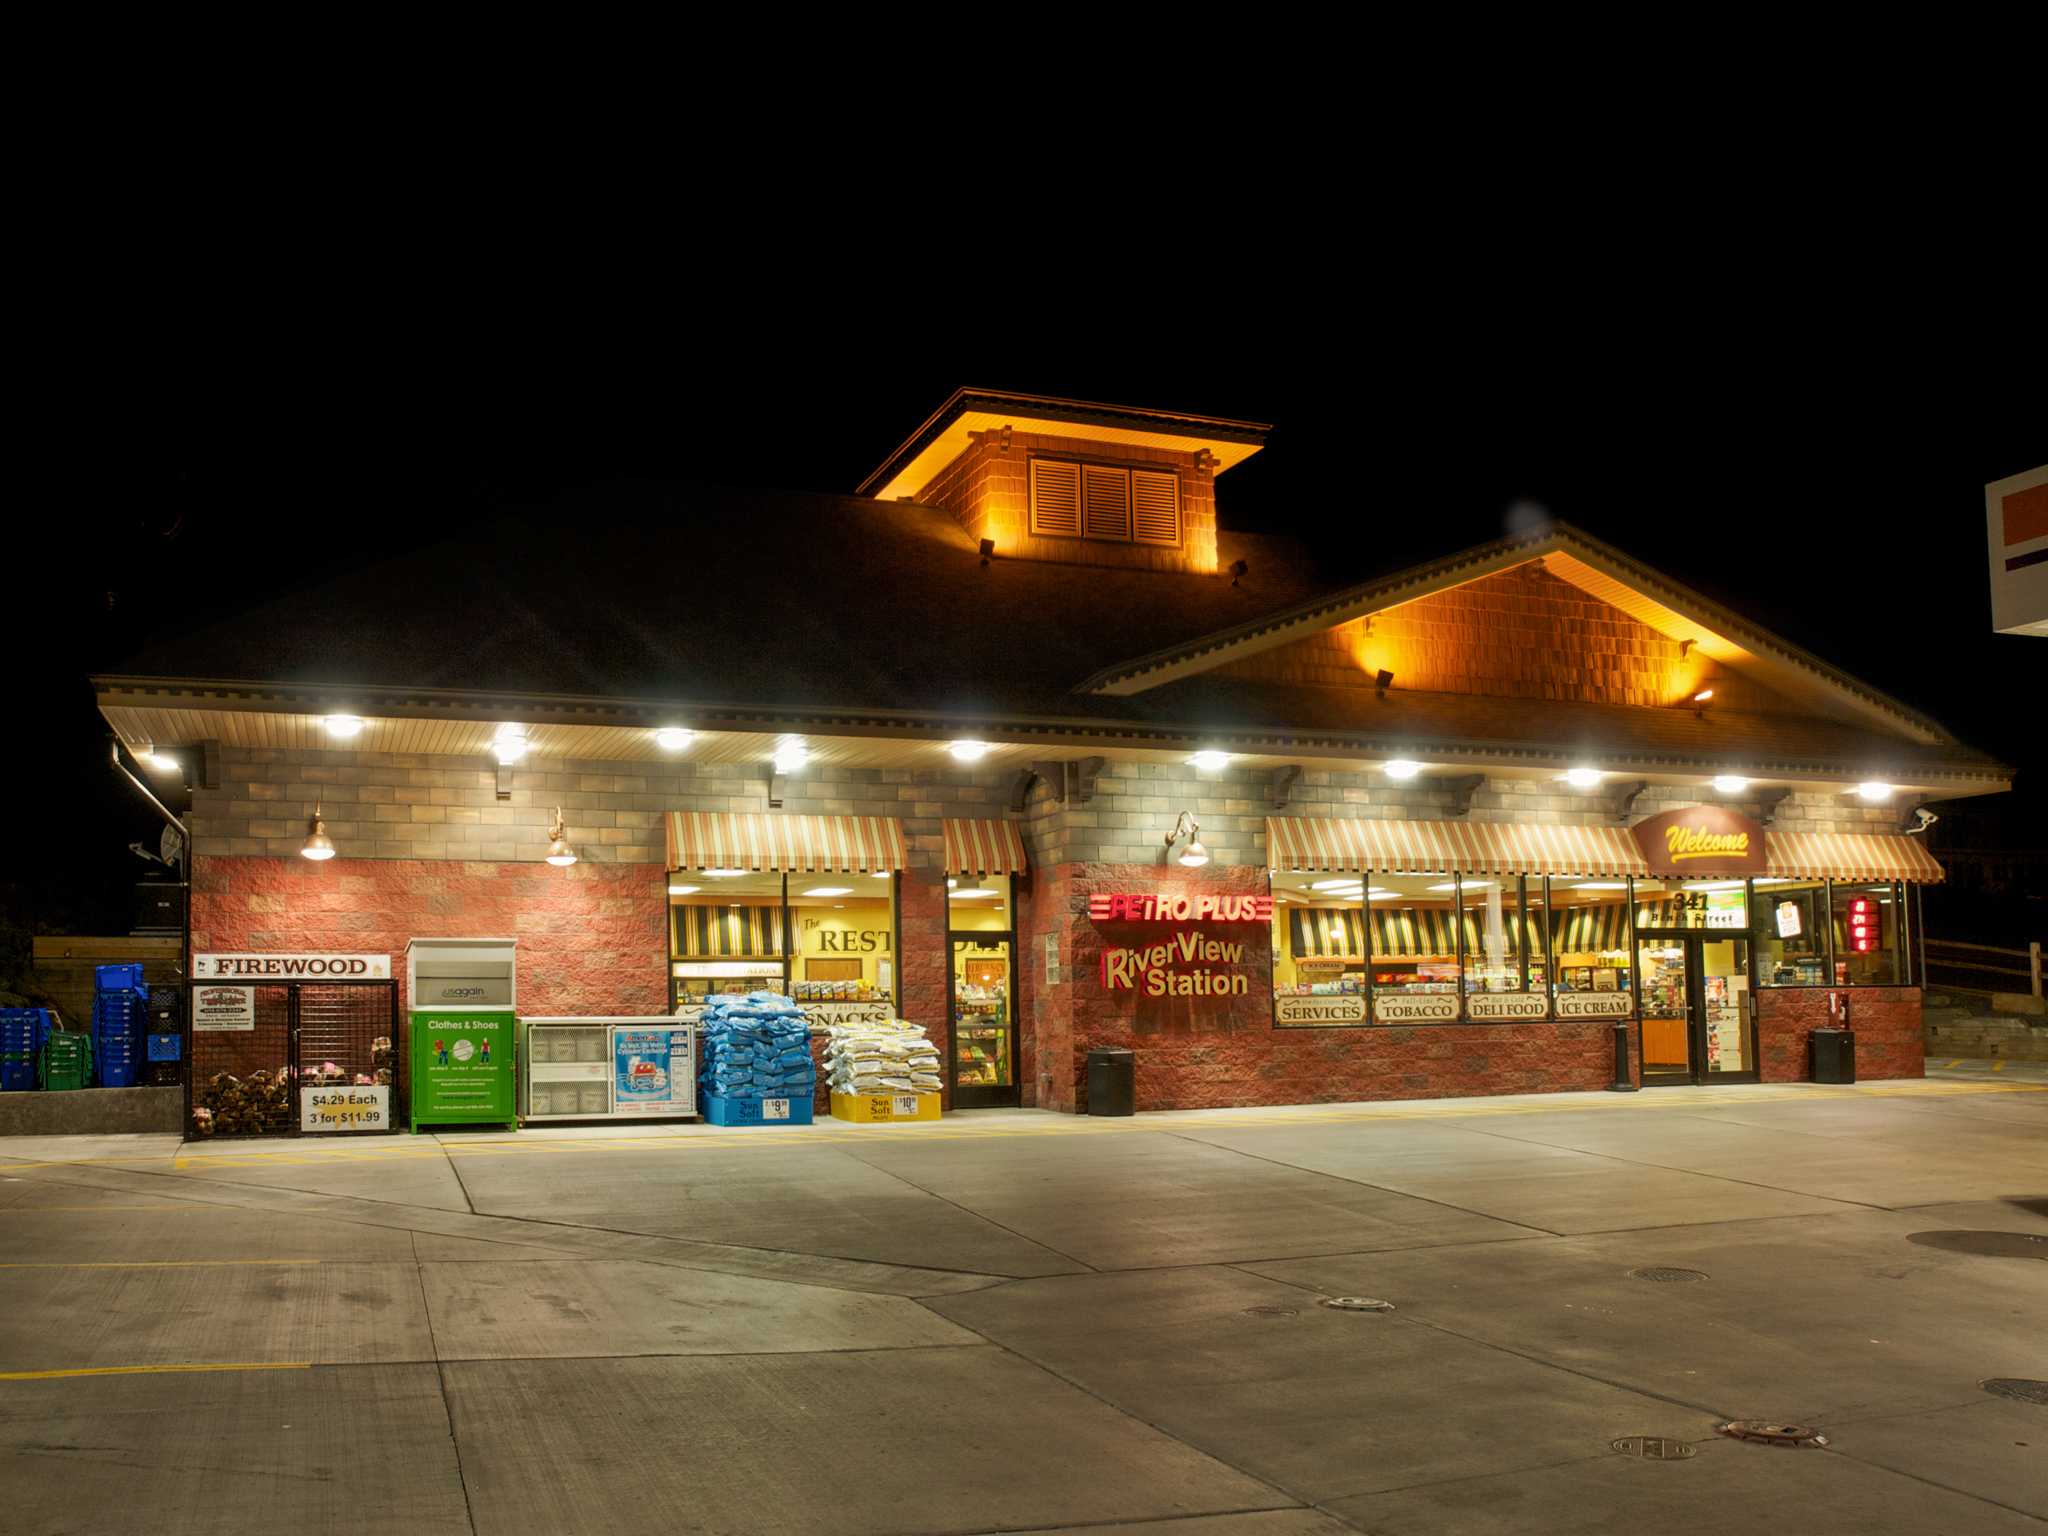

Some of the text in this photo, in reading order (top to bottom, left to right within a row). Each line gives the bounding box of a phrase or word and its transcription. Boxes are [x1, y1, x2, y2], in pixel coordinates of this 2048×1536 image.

[1665, 825, 1749, 853] Welcome
[1111, 894, 1257, 921] PETRO PLUS
[1674, 893, 1709, 911] 341
[1651, 913, 1688, 921] Bench
[1694, 913, 1733, 921] Street
[804, 918, 821, 930] The
[818, 930, 891, 953] REST
[1105, 931, 1243, 989] RiverView
[214, 957, 368, 976] FIREWOOD
[960, 963, 1005, 972] EMERGENCY
[1147, 969, 1248, 996] Station
[200, 987, 247, 998] PROFESSIONAL
[444, 986, 484, 997] usagain
[1282, 1006, 1361, 1020] SERVICES
[1383, 1005, 1452, 1017] TOBACCO
[1473, 1003, 1544, 1016] DELI FOOD
[1561, 1002, 1628, 1014] ICE CREAM
[428, 1020, 499, 1029] Clothes & Shoes
[804, 1012, 886, 1027] SNACKS
[626, 1034, 661, 1042] AmeriGas
[312, 1094, 378, 1106] $4.29 Each
[740, 1101, 759, 1109] Sun
[871, 1098, 889, 1106] Sun
[739, 1109, 760, 1118] Soft
[870, 1106, 890, 1115] Soft
[310, 1111, 380, 1123] 3 for $11.99
